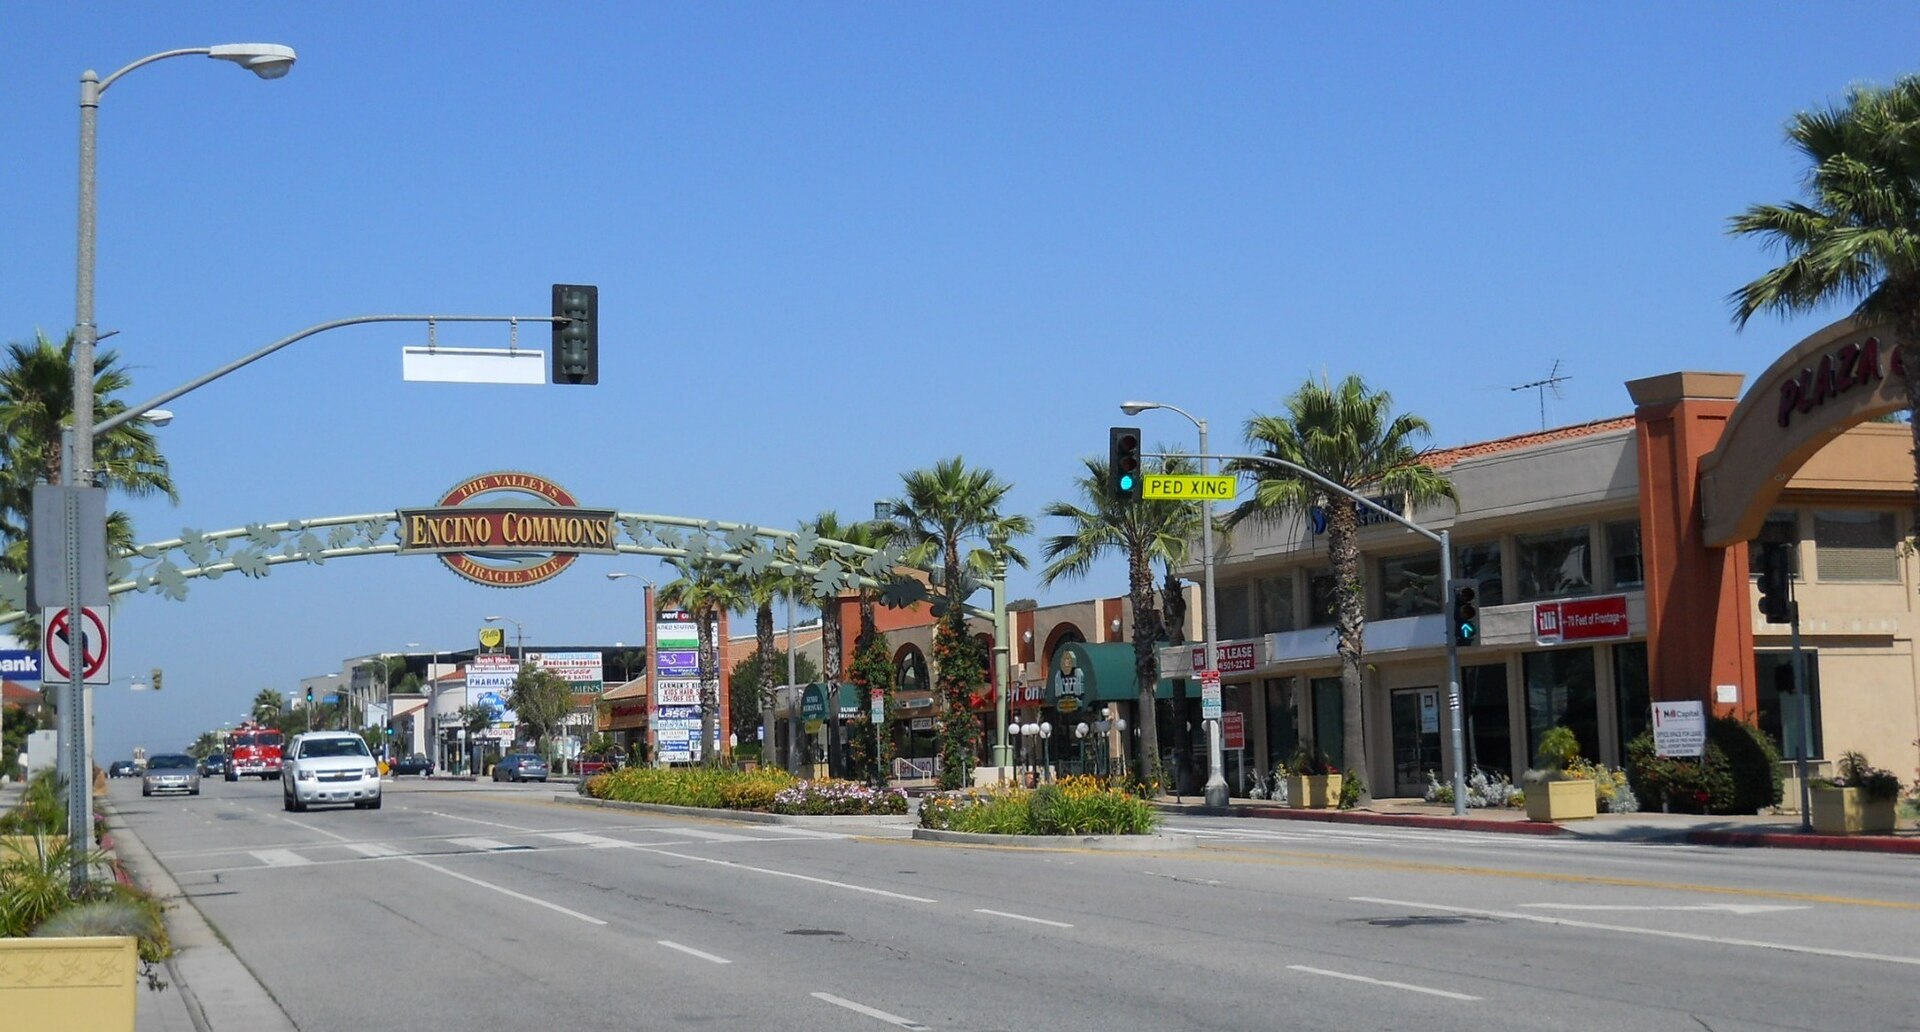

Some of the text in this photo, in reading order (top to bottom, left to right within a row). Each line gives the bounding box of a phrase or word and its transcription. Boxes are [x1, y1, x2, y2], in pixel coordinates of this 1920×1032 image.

[1778, 336, 1884, 428] PLAZA
[457, 475, 560, 499] THE VALLEY'S
[1151, 480, 1227, 495] PED XING
[411, 512, 608, 546] ENCINO COMMONS
[457, 558, 561, 583] MIRACLE MILE
[662, 611, 689, 619] verio
[1216, 650, 1225, 660] OR
[1226, 646, 1253, 660] LEASE
[0, 656, 38, 672] ank
[469, 678, 511, 686] PHARMAC
[1007, 685, 1040, 702] erion
[658, 707, 692, 718] Laser
[489, 729, 513, 737] SOUND
